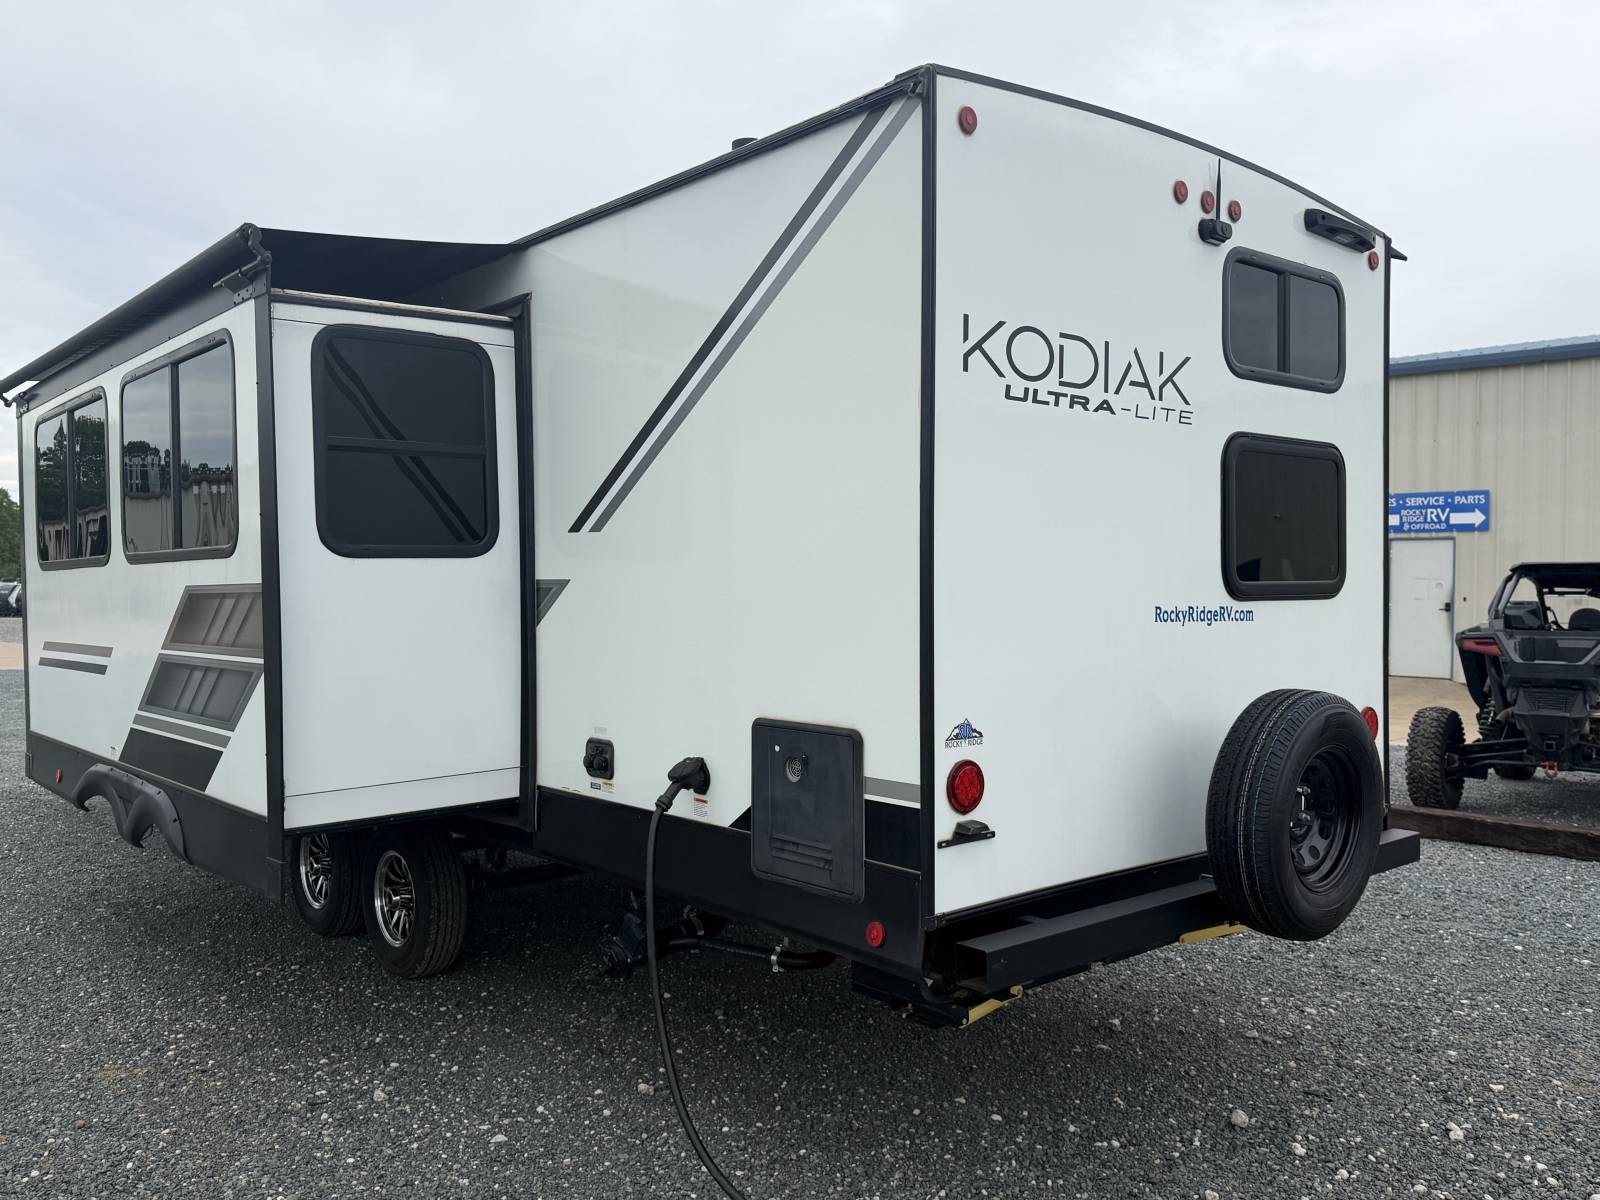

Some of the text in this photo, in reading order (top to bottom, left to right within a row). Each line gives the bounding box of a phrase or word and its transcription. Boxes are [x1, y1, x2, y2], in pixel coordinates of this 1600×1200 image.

[963, 313, 1191, 405] KODIAK
[1406, 496, 1445, 506] SERVICE
[1455, 495, 1485, 504] PARTS
[1401, 509, 1427, 517] ROCKY
[1427, 508, 1450, 522] RV
[1403, 523, 1409, 531] &
[1155, 605, 1254, 626] RockyRidgeRV.com
